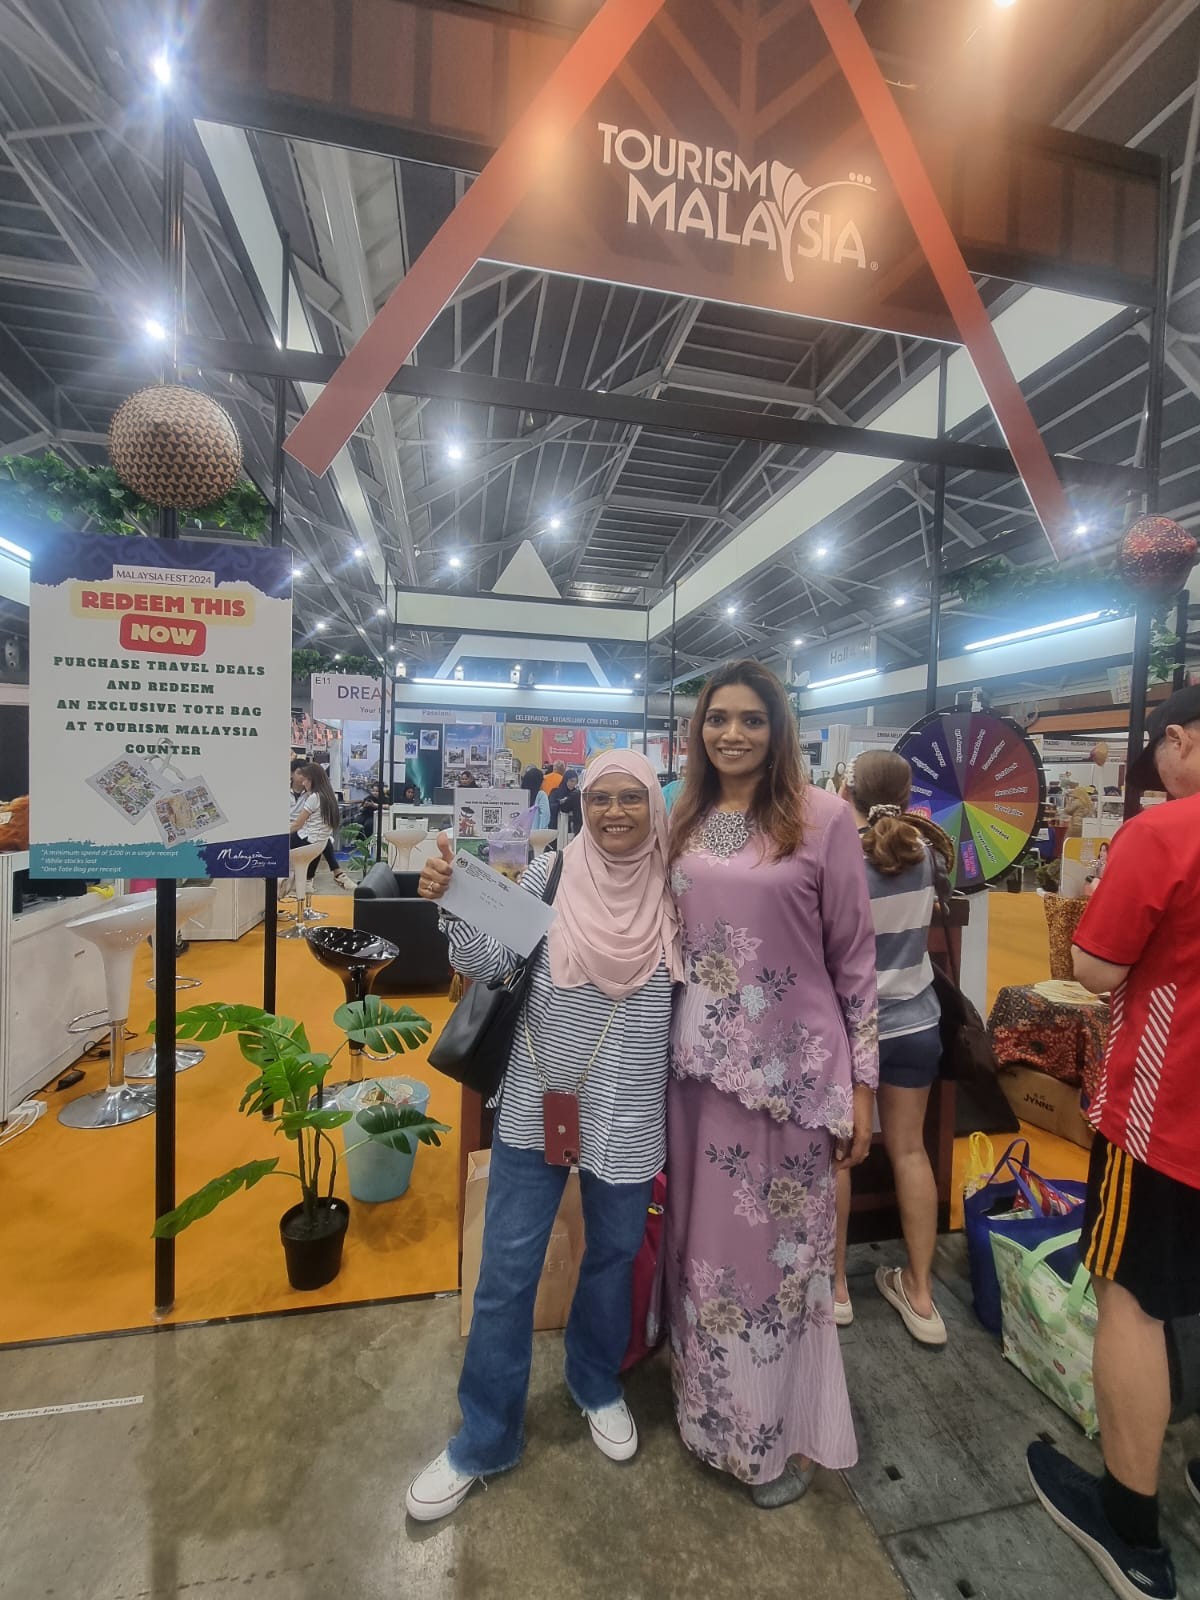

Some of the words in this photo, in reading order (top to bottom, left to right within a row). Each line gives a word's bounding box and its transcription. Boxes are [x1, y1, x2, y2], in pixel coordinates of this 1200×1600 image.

[597, 122, 768, 197] TOURISM
[626, 172, 867, 282] MALAYSIA
[116, 569, 164, 582] MALAYSIA
[165, 572, 187, 583] FEST
[189, 574, 212, 585] 2024
[81, 591, 185, 613] REDEEM
[191, 597, 246, 617] THIS
[130, 623, 197, 646] NOW
[53, 656, 140, 670] PURCHASE
[147, 661, 208, 673] TRAVEL
[216, 665, 265, 676] DEALS
[107, 680, 141, 692] AND
[148, 682, 214, 694] REDEEM
[315, 676, 331, 685] E11
[57, 700, 80, 710] AN
[87, 701, 177, 714] EXCLUSIVE
[184, 704, 223, 716] TOTE
[231, 707, 262, 717] BAG
[65, 721, 87, 731] AT
[94, 723, 169, 735] TOURISM
[176, 725, 258, 737] MALAYSIA
[125, 744, 202, 755] COUNTER
[81, 849, 100, 857] spend
[216, 848, 272, 871] Malaysia
